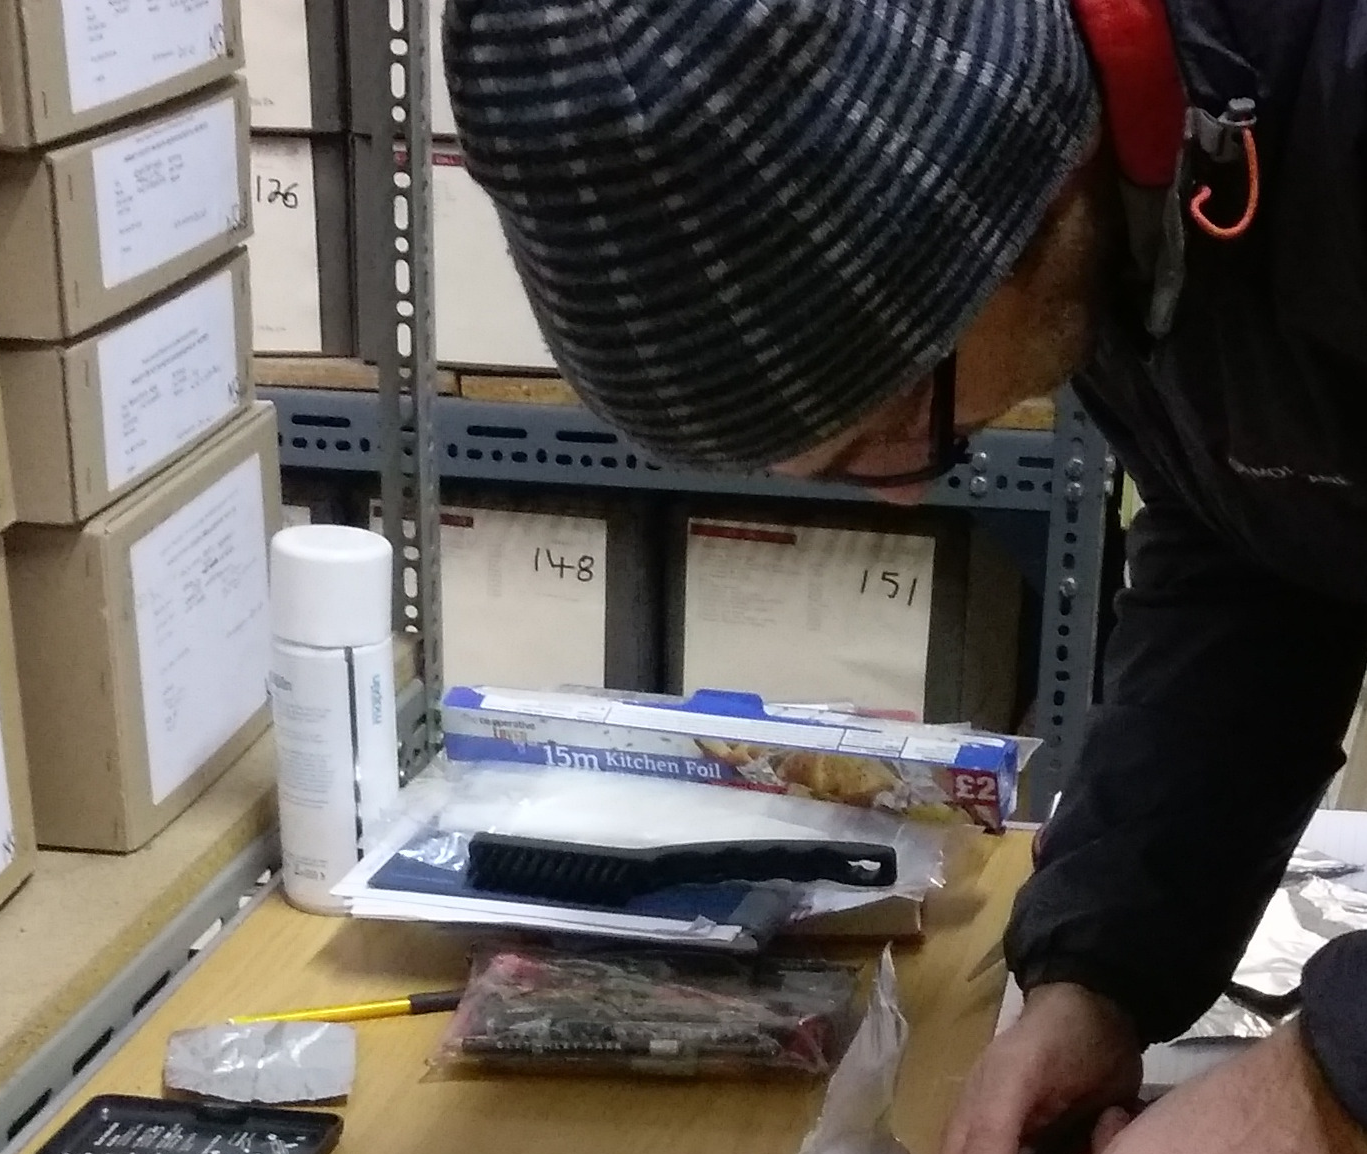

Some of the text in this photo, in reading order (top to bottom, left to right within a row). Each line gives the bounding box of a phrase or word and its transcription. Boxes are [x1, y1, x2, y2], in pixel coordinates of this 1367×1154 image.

[533, 547, 595, 583] 148
[860, 571, 918, 606] 151
[543, 744, 723, 780] 15m Kitchen Foil
[954, 774, 998, 801] £2
